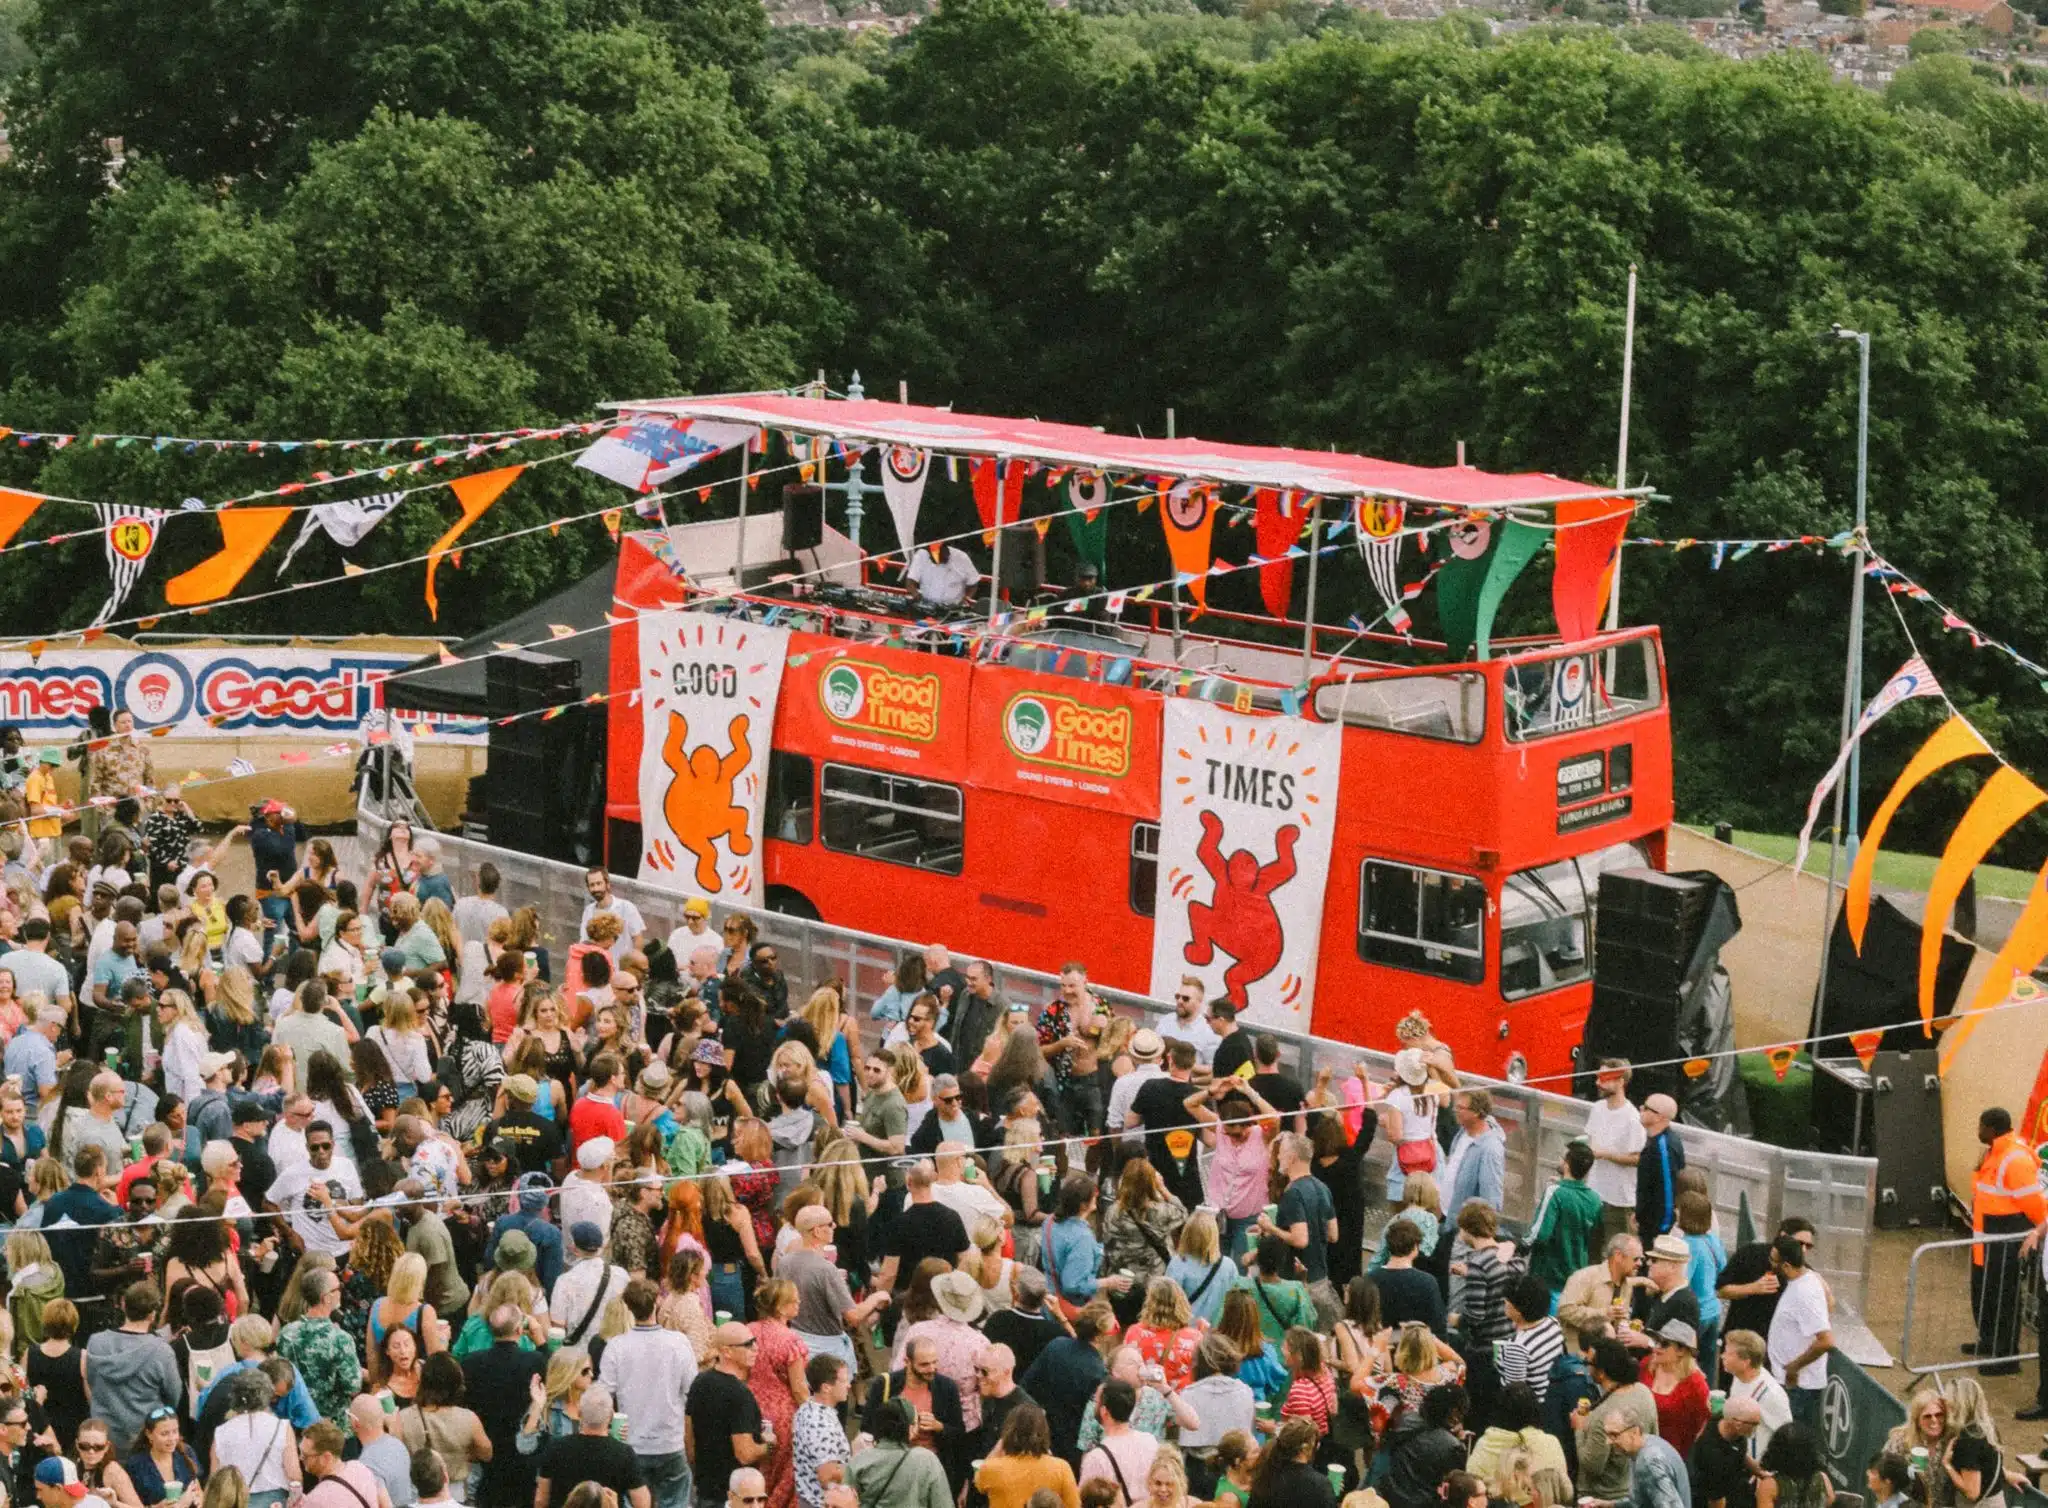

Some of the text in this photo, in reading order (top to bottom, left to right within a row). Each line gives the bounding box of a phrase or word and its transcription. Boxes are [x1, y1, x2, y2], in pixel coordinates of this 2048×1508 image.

[206, 670, 354, 718] Good
[673, 662, 737, 698] GOOD
[867, 672, 934, 708] Good
[867, 697, 932, 734] Times
[1055, 704, 1125, 742] Good
[1055, 731, 1122, 769] Times
[1205, 758, 1295, 811] TIMES
